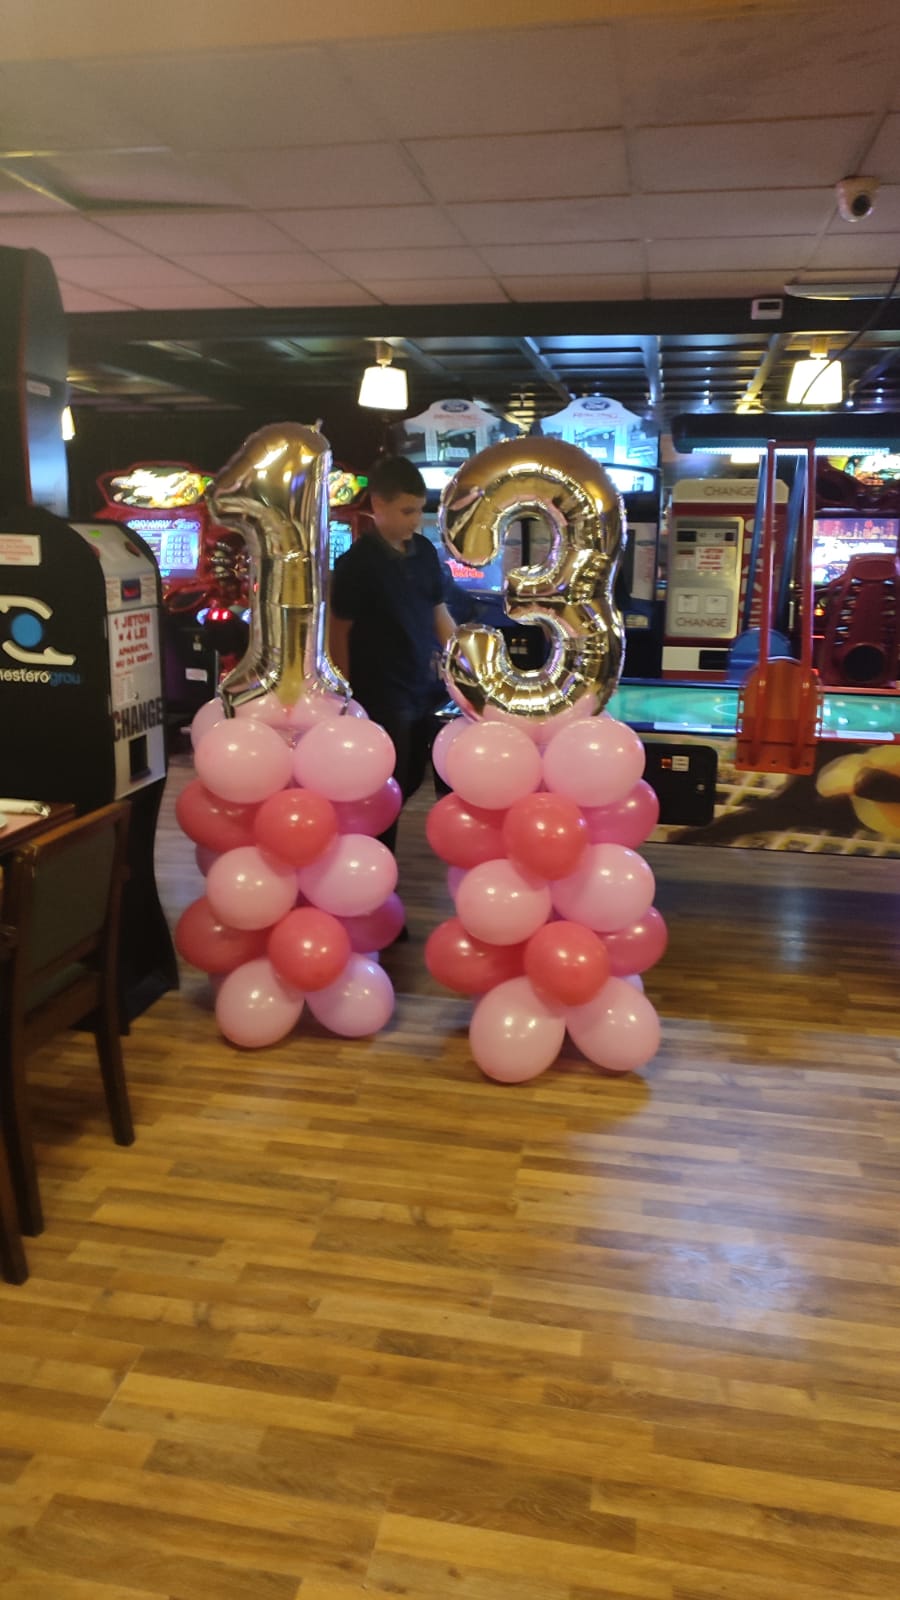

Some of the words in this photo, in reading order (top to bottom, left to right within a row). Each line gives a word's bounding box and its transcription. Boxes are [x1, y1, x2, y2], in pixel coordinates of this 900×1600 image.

[703, 485, 758, 498] CHANGE
[122, 611, 151, 629] JETON
[674, 616, 729, 629] CHANGE
[134, 626, 148, 640] LEI
[112, 696, 163, 742] CHANGE
